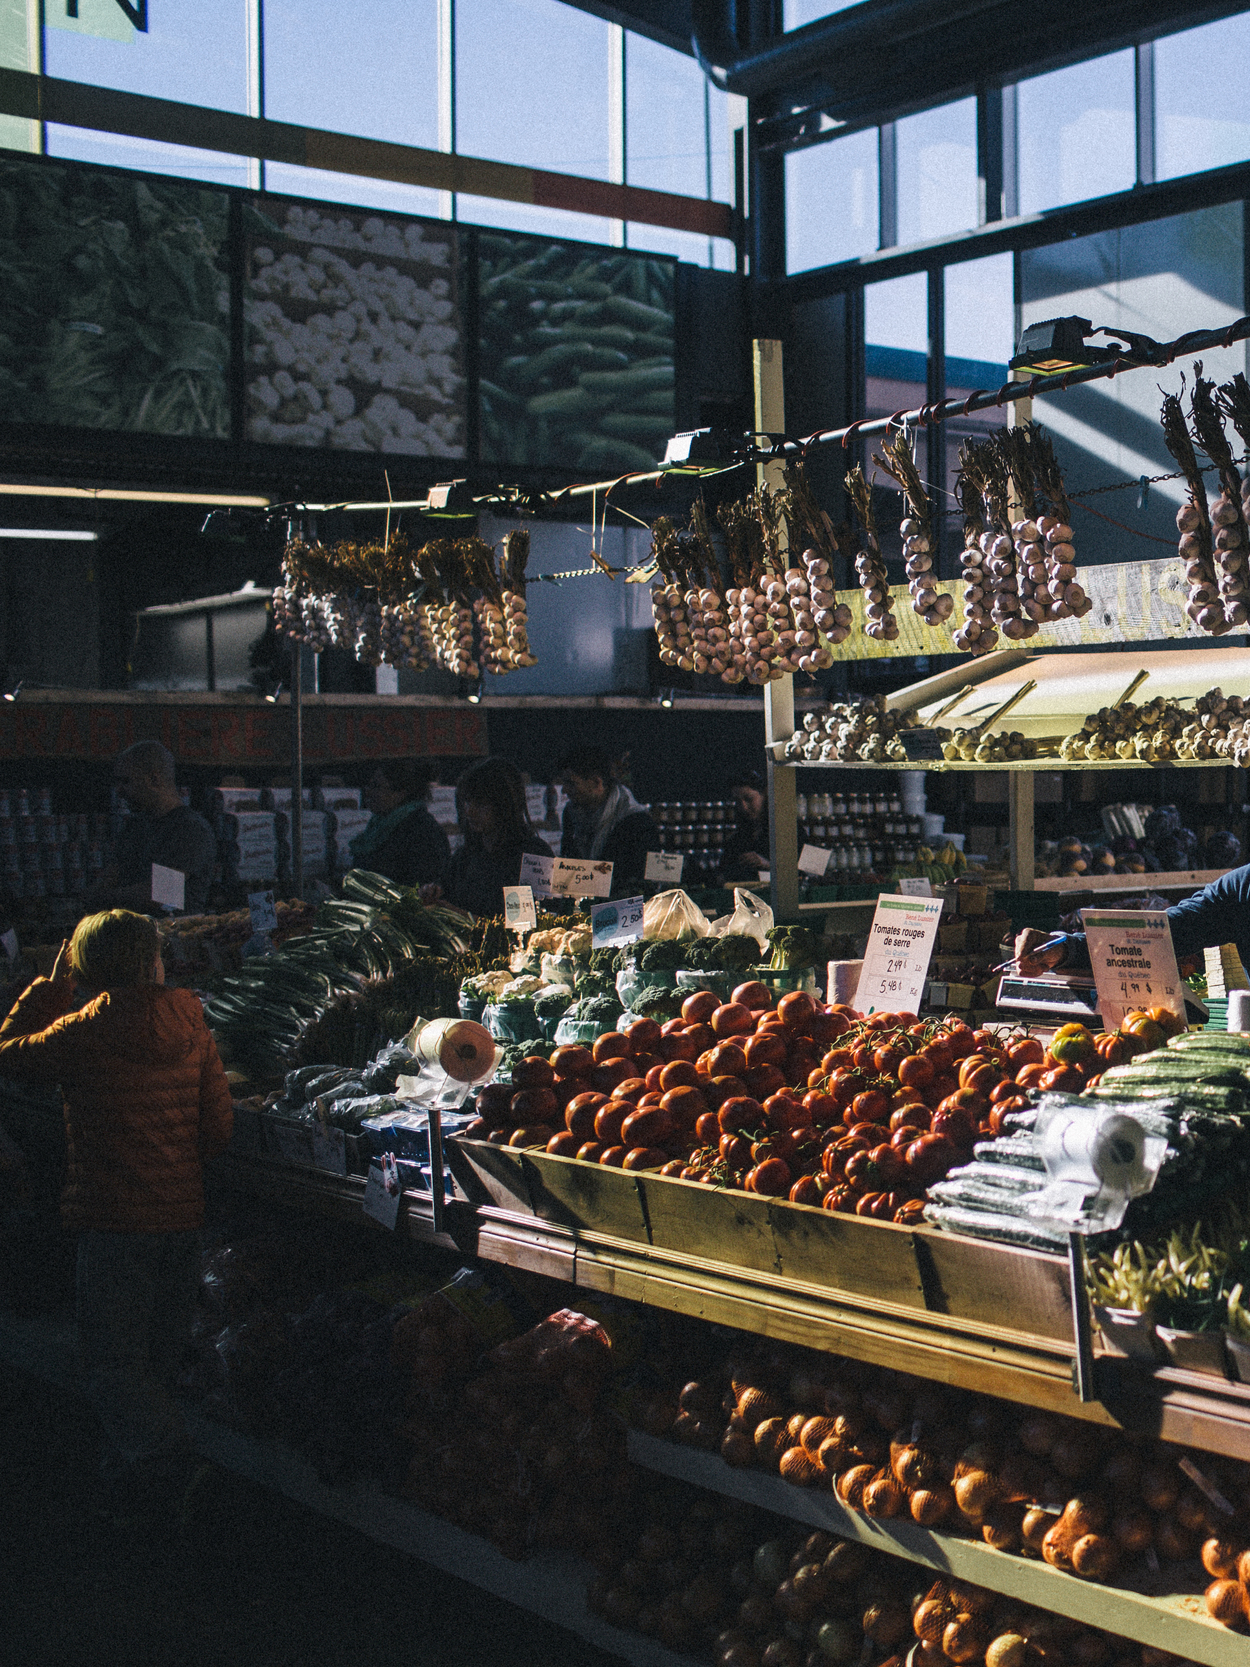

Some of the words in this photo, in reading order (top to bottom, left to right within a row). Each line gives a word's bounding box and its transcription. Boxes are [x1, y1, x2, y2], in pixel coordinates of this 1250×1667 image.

[873, 923, 901, 936] Tomates
[901, 928, 925, 939] rouges
[883, 936, 893, 946] de
[893, 939, 911, 948] serre
[1109, 944, 1143, 957] Tomate
[1106, 958, 1152, 969] ancestrale
[1127, 971, 1151, 979] Québec
